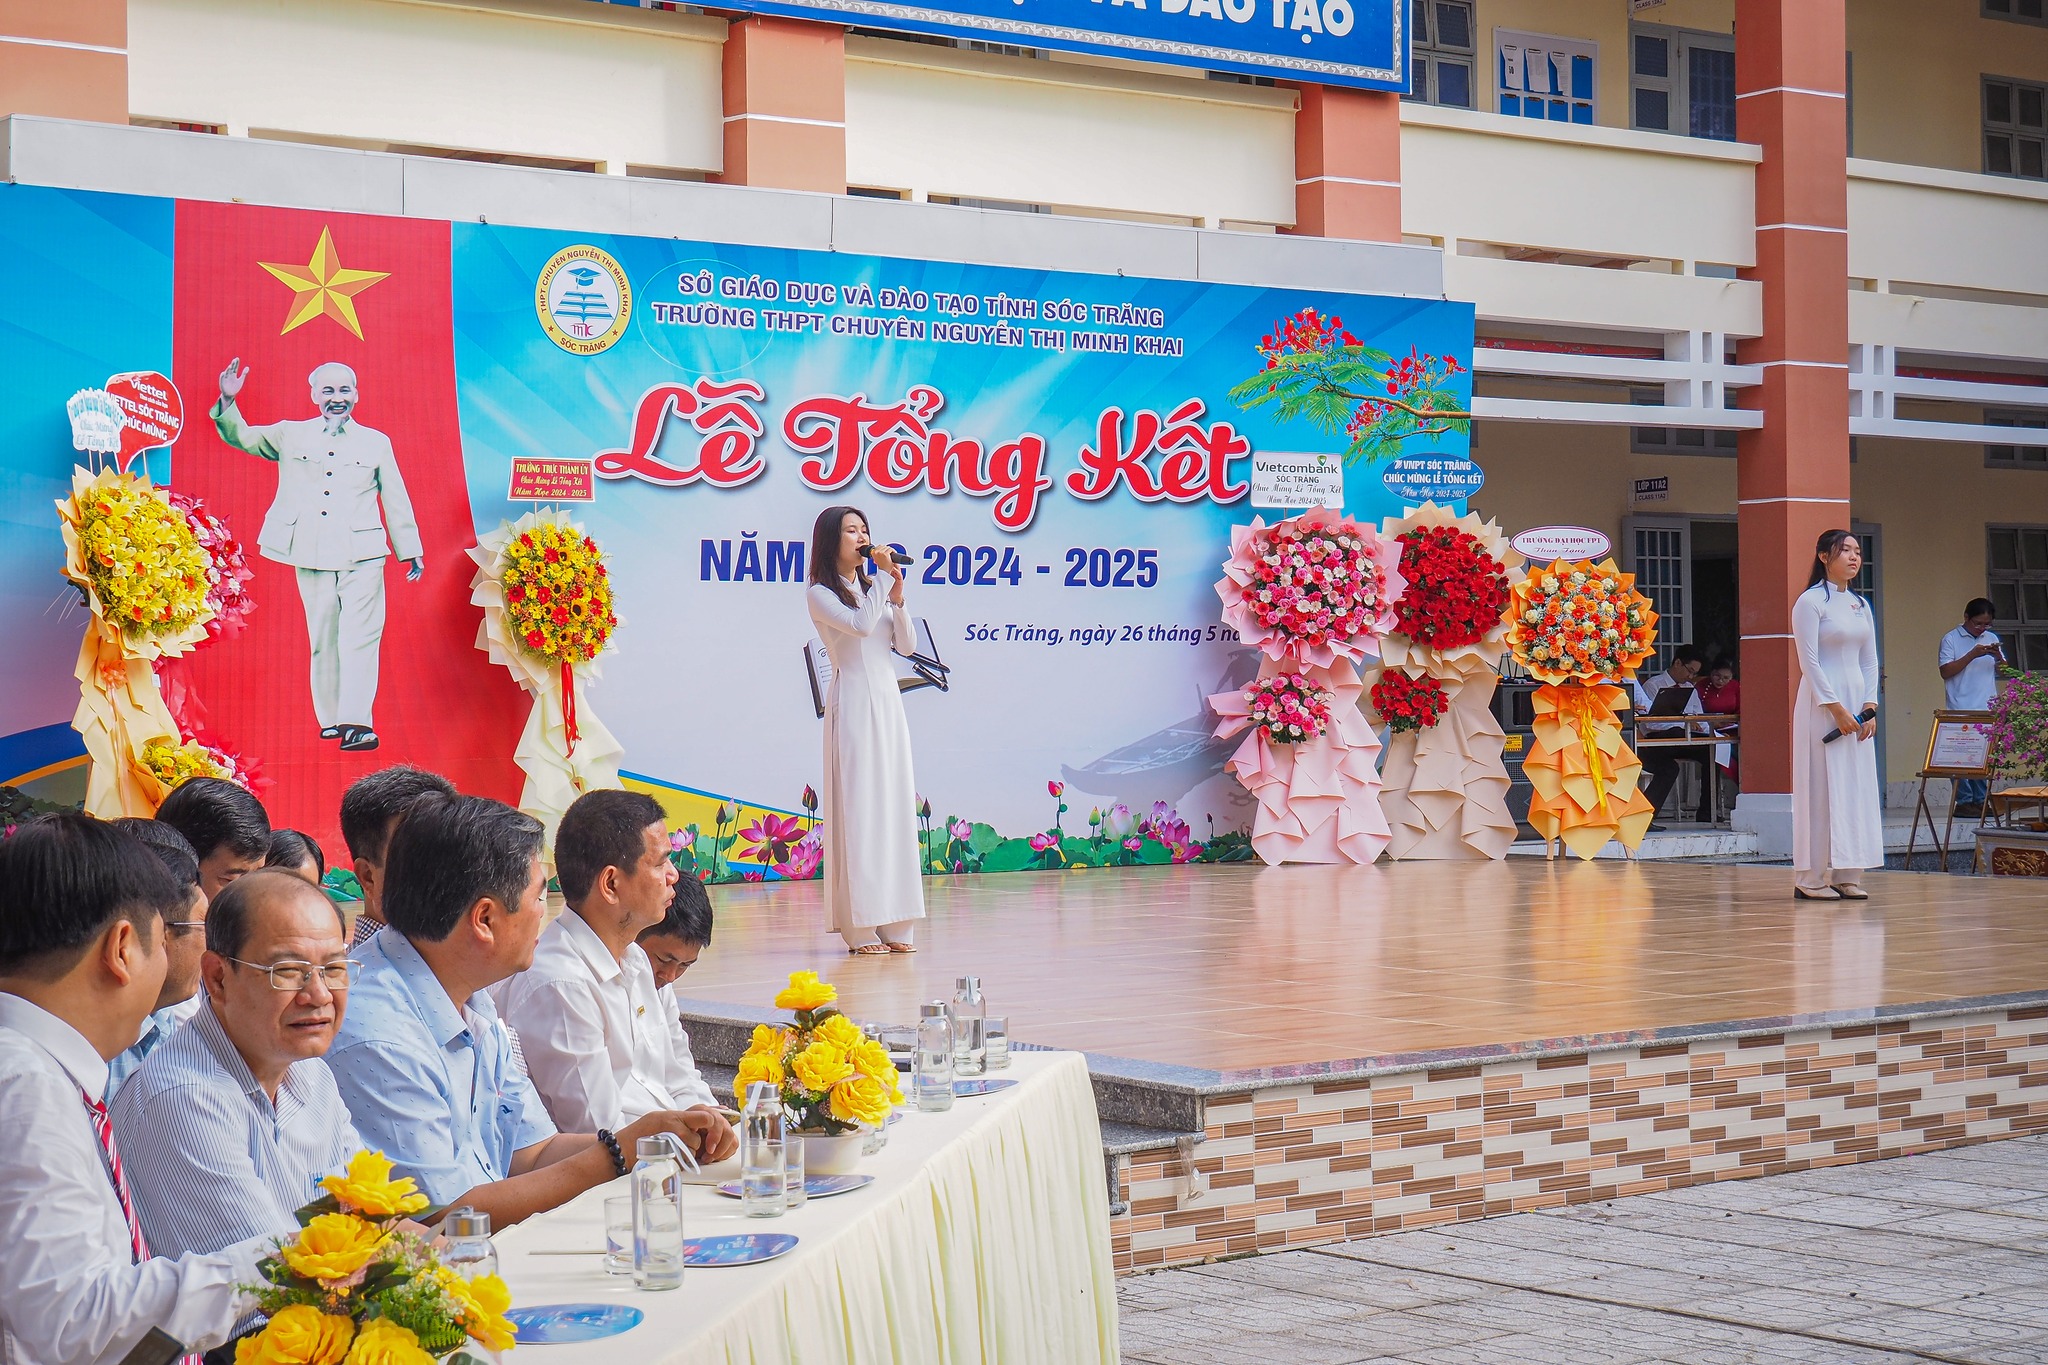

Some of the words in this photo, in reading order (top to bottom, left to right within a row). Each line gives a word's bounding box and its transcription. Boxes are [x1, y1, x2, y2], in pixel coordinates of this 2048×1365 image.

[1272, 0, 1354, 44] TẠO
[539, 289, 547, 313] THPT
[543, 255, 566, 286] CHUYÊN
[567, 248, 601, 260] NGUYỄN
[602, 256, 613, 271] THỊ
[613, 268, 627, 291] MINH
[621, 294, 629, 317] KHAI
[679, 270, 712, 295] SỞ
[721, 275, 778, 299] GIÁO
[787, 283, 835, 306] DỤC
[843, 283, 874, 306] VÀ
[880, 287, 928, 310] ĐÀO
[935, 294, 979, 317] TẠO
[985, 292, 1036, 318] TỈNH
[1043, 299, 1087, 321] SÓC
[1093, 303, 1164, 328] TRĂNG
[652, 303, 755, 328] TRƯỜNG
[763, 311, 824, 332] THPT
[831, 316, 925, 341] CHUYÊN
[932, 320, 1023, 346] NGUYỄN
[1030, 329, 1065, 352] THỊ
[1072, 333, 1128, 353] MINH
[1135, 336, 1184, 356] KHAI
[560, 337, 577, 351] SÓC
[579, 340, 607, 353] TRĂNG
[123, 415, 142, 432] HÚC
[138, 402, 153, 419] SÓC
[155, 410, 179, 429] TRĂNG
[593, 377, 764, 486] Lễ
[783, 385, 1050, 530] Tổng
[1067, 400, 1249, 500] Kết
[1403, 460, 1425, 470] VNPT
[1427, 459, 1442, 470] SÓC
[1444, 459, 1471, 471] TRĂNG
[1256, 461, 1338, 474] Vietcombank
[1276, 474, 1291, 483] SÓC
[1293, 475, 1320, 484] TRĂNG
[1383, 472, 1405, 483] CHÚC
[1407, 472, 1431, 484] MỪNG
[1433, 471, 1441, 484] LỄ
[1443, 471, 1466, 484] TỔNG
[1467, 472, 1482, 484] KẾT
[551, 488, 567, 497] 2024
[571, 489, 587, 497] 2025
[1522, 536, 1553, 544] TRƯỜNG
[700, 530, 805, 583] NĂM
[922, 545, 1022, 586] 2024
[1064, 548, 1158, 588] 2025
[964, 622, 1000, 642] Sóc
[1004, 623, 1064, 645] Trăng,
[1069, 623, 1117, 647] ngày
[1120, 624, 1144, 641] 26
[1148, 624, 1202, 646] tháng
[1206, 625, 1217, 641] 5
